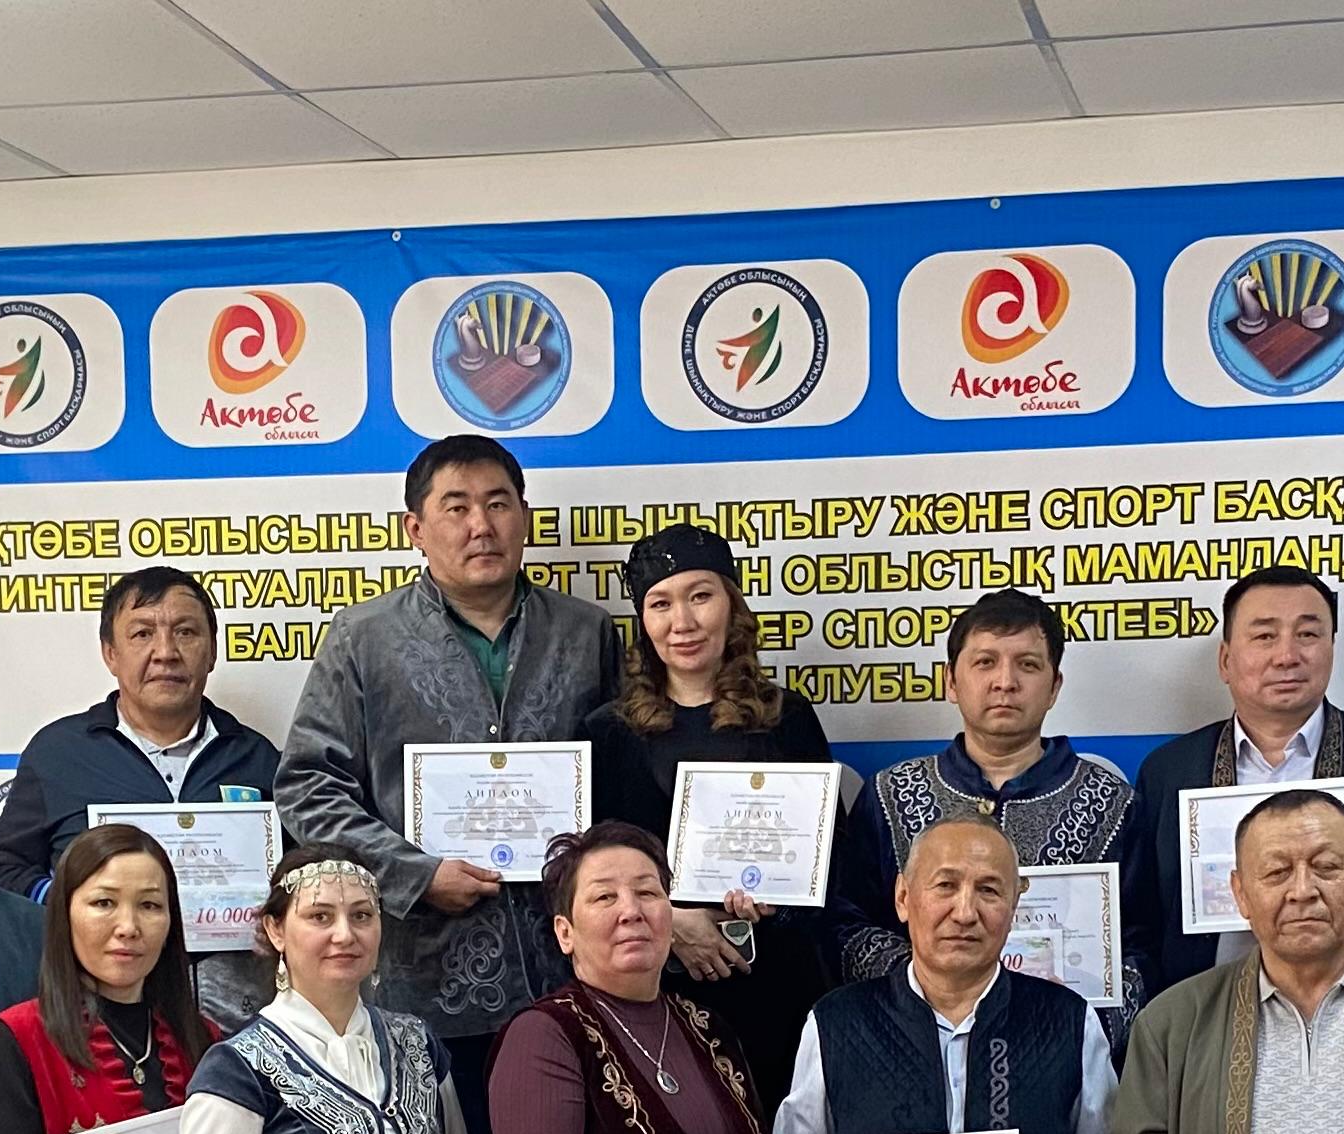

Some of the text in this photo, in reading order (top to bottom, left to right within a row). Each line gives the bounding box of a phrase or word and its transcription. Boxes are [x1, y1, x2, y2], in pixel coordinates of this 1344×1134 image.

[1020, 396, 1081, 411] облысы
[890, 490, 1031, 536] ЖӘНЕ
[1040, 482, 1205, 531] СПОРТ
[780, 546, 1055, 594] ОБЛЫСТЫҚ
[464, 788, 533, 799] ДИПЛОМ
[723, 809, 783, 820] ДИПЛОМ
